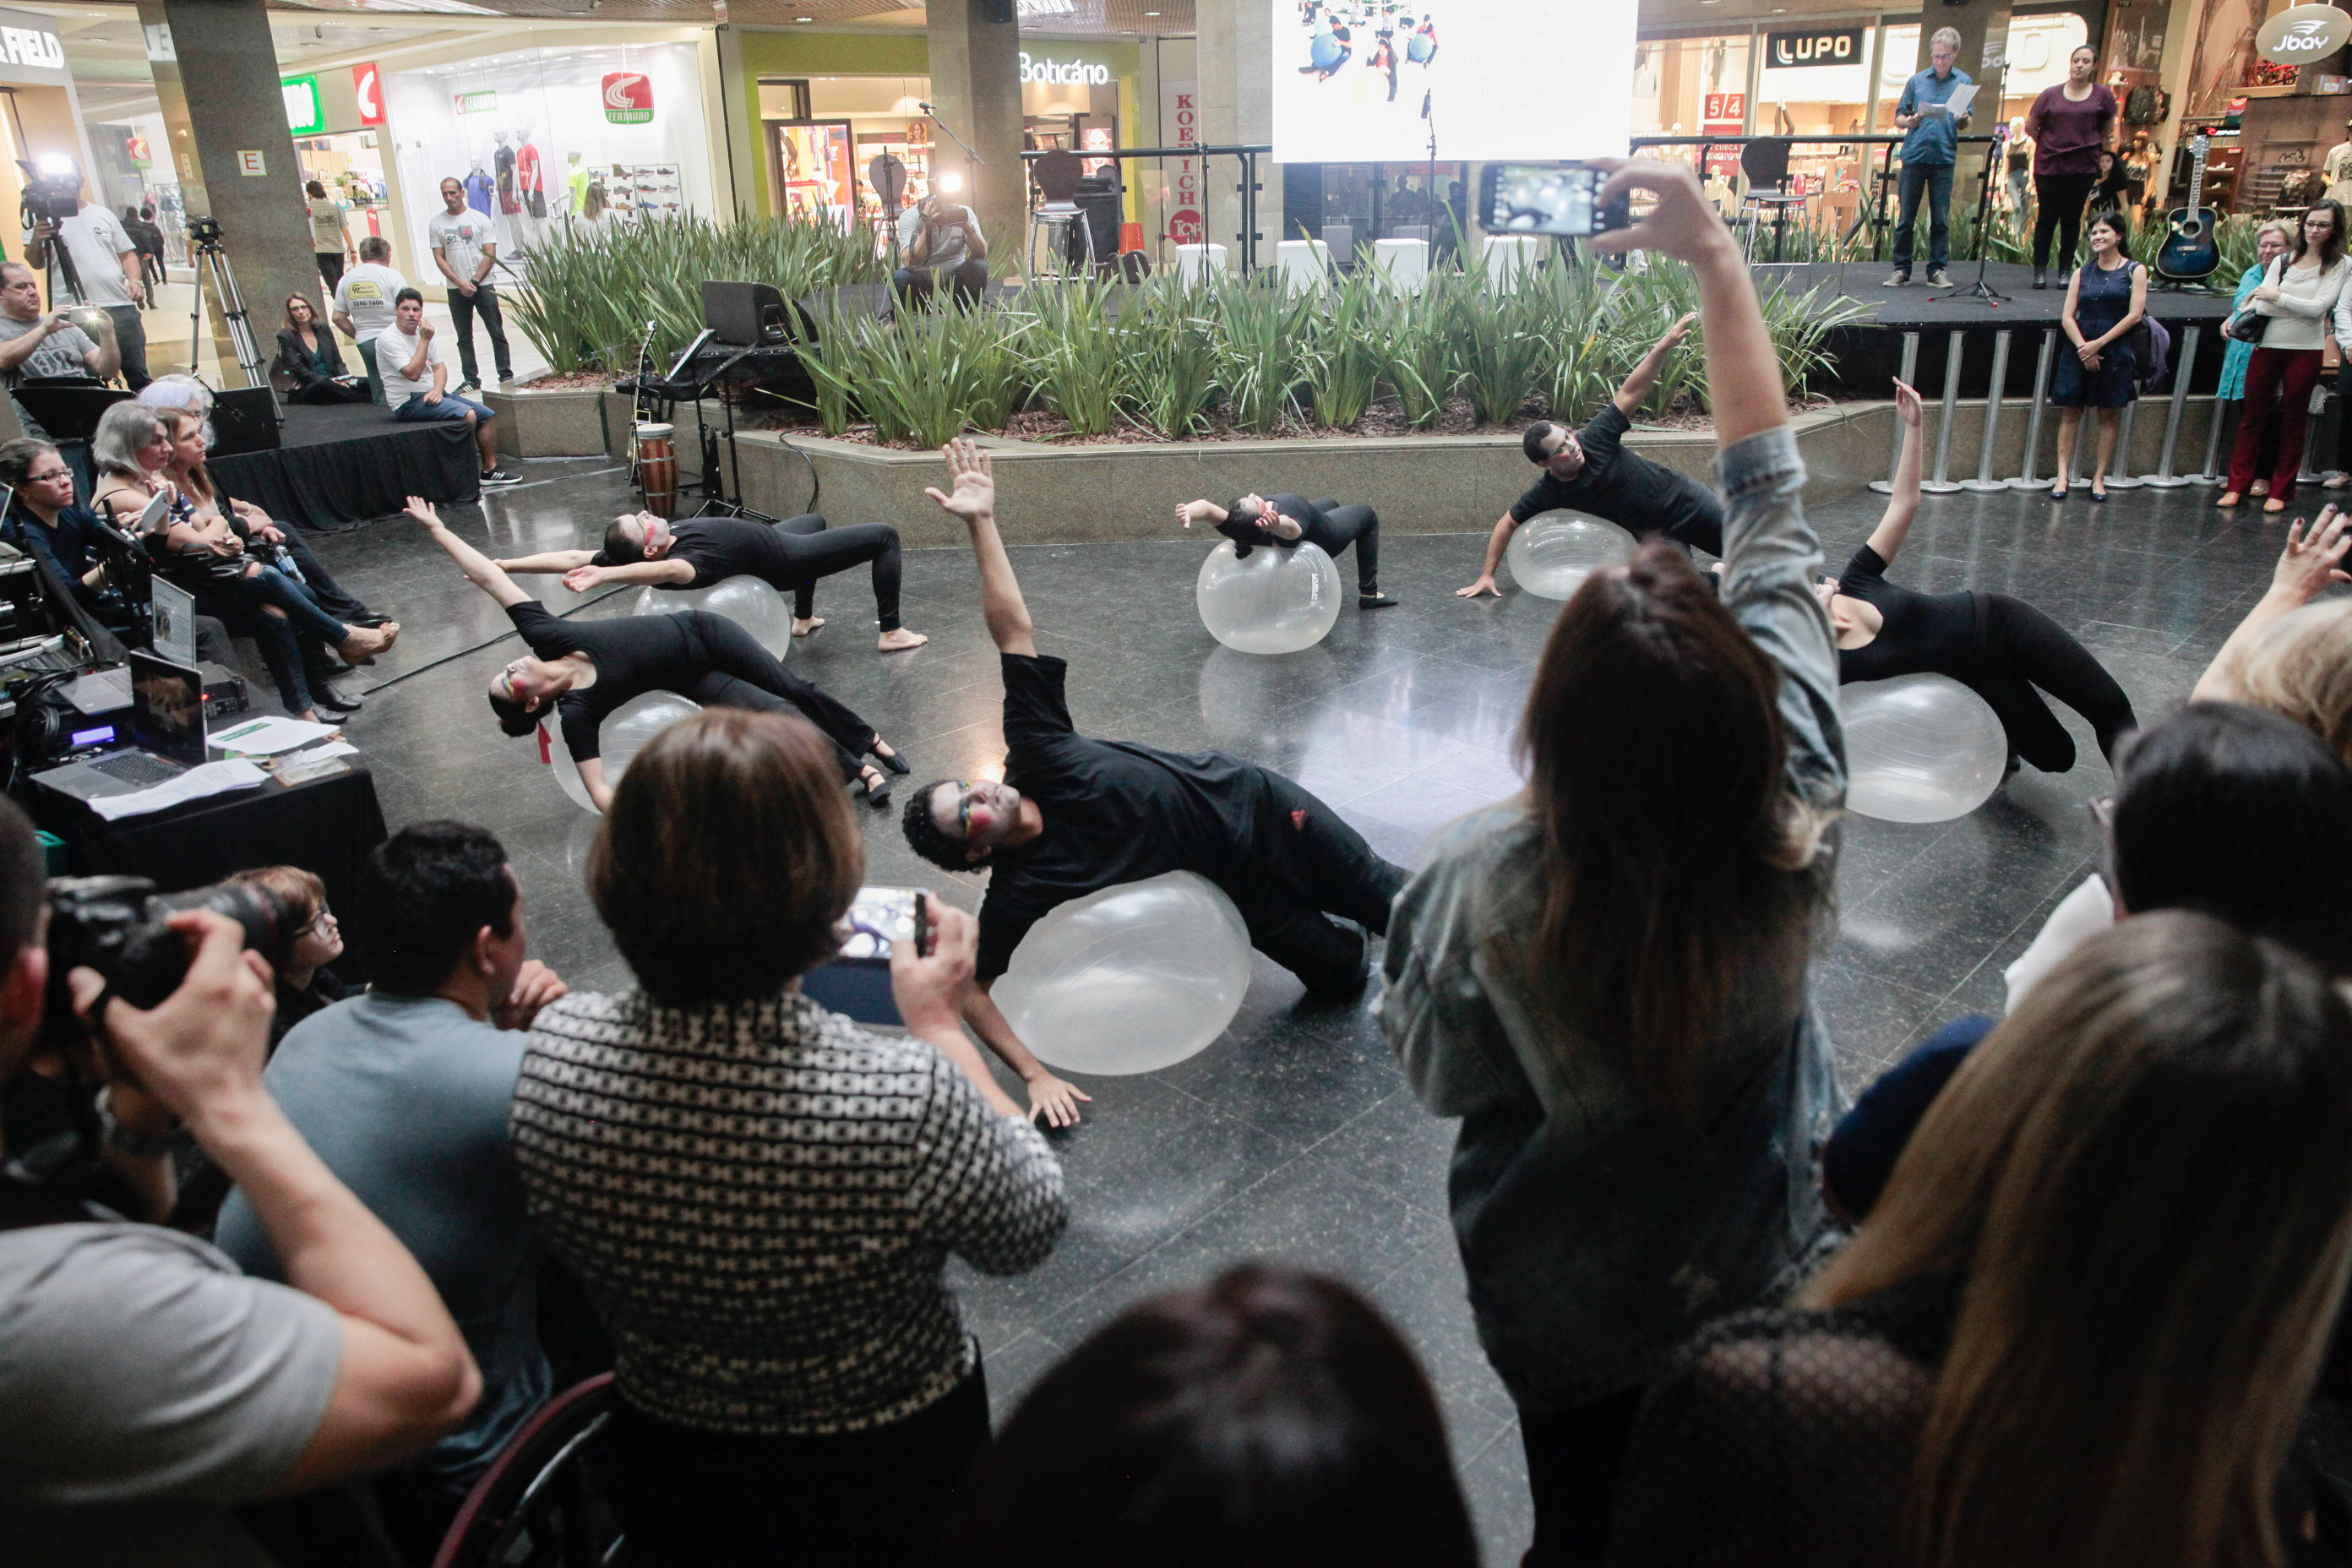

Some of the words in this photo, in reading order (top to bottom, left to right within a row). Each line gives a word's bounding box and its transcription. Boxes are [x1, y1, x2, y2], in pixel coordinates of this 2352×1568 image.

[1777, 35, 1851, 64] LUPO
[2273, 35, 2329, 52] Jbay
[608, 112, 650, 122] CENTAURO
[1709, 101, 1719, 117] 5
[1729, 100, 1740, 117] 4
[1175, 94, 1196, 205] KOEICH
[244, 153, 259, 170] E
